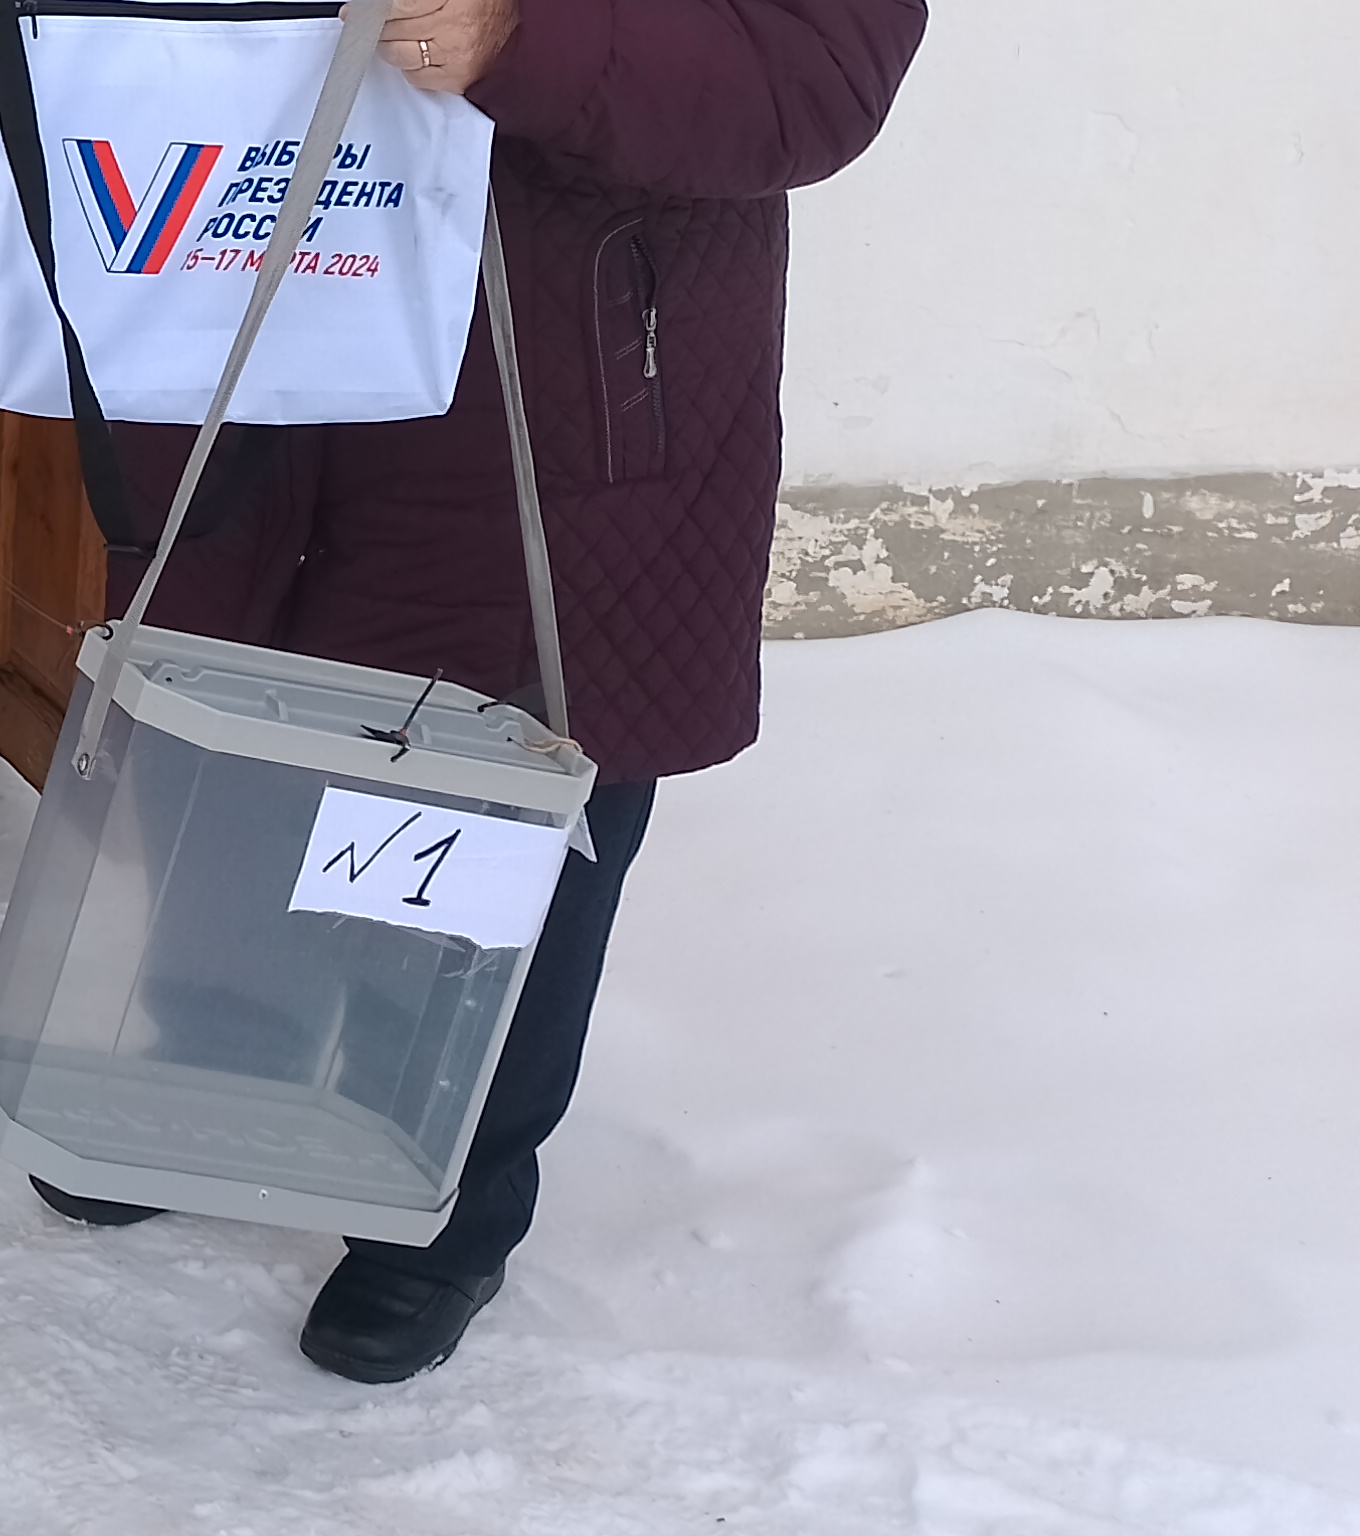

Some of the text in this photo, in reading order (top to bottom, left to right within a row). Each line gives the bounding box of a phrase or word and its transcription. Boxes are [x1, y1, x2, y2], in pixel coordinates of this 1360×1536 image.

[236, 140, 372, 173] ВЫБЫ
[217, 176, 405, 211] ПРЕЗДЕНТА
[196, 213, 324, 243] РОССИ
[323, 253, 381, 278] 2024
